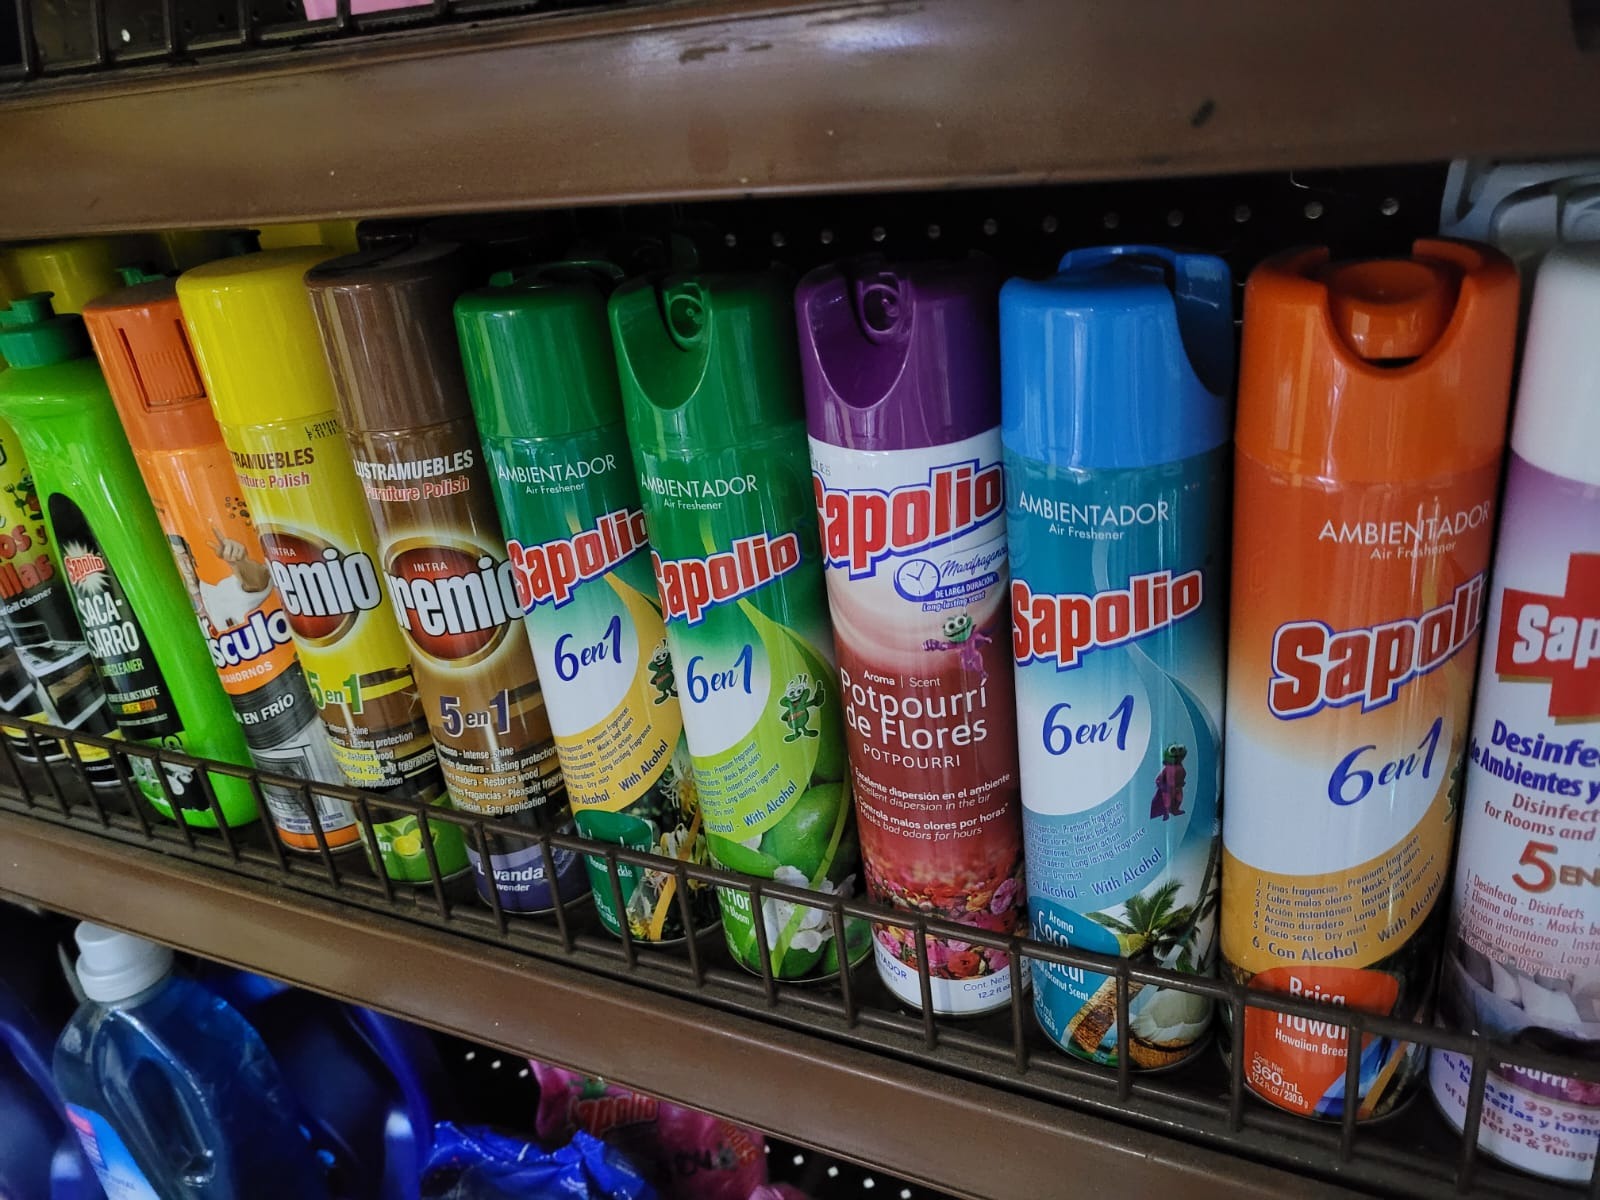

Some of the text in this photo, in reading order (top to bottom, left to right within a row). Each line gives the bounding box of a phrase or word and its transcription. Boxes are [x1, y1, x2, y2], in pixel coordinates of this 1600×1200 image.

[269, 472, 310, 488] Polish
[354, 450, 474, 481] LUSTRAMUEBLES
[498, 454, 616, 483] AMBIENTADOR
[423, 475, 470, 499] Polish
[541, 482, 584, 494] Freshener
[642, 472, 758, 498] AMBIENTADOR
[664, 499, 722, 510] Air Freshener
[1019, 491, 1169, 526] AMBIENTADOR
[1049, 524, 1124, 540] Air Freshener
[1319, 501, 1490, 544] AMBIENTADOR
[507, 508, 649, 613] Sapolio
[1370, 541, 1456, 560] Air Freshener
[64, 554, 105, 584] Sapolio
[413, 562, 448, 572] INTRA
[271, 547, 382, 617] emio
[384, 556, 523, 636] remio
[935, 589, 944, 599] DE
[944, 584, 966, 597] LARGA
[78, 592, 123, 627] SACA-
[1011, 569, 1202, 668] Sapolio
[87, 621, 139, 658] SARRO
[206, 608, 293, 669] sculo
[1269, 572, 1487, 719] Sapoli
[307, 671, 362, 714] 5 en 1
[863, 670, 940, 688] Aroma Scent
[840, 667, 988, 721] Potpourrí
[244, 711, 259, 725] EN
[261, 693, 295, 721] FRÍO
[439, 689, 510, 738] 5 en 1
[376, 732, 413, 748] protection
[846, 702, 988, 749] de Flores
[463, 748, 489, 760] Intense
[640, 739, 669, 776] Alcohol
[863, 743, 961, 769] POTPOURRI
[1491, 719, 1600, 768] Desinfe
[491, 759, 520, 773] Lasting
[521, 745, 557, 768] protection
[1480, 749, 1581, 796] Ambientes
[484, 768, 539, 787] Restores wood
[508, 780, 541, 798] Pleasant
[582, 772, 641, 804] Alcohol With
[889, 773, 1010, 802] dispersión en el ambiente
[487, 804, 504, 814] Easy
[504, 796, 547, 815] application
[743, 779, 797, 826] With Alcohol
[890, 796, 975, 812] dispersion in the
[882, 822, 983, 841] bad odors for hours
[890, 816, 921, 829] malos
[923, 822, 957, 831] olores
[959, 817, 977, 830] por
[1063, 818, 1090, 834] Premium
[1484, 800, 1596, 841] for Rooms and
[1071, 855, 1089, 868] Long
[1089, 849, 1114, 865] lasting
[1114, 827, 1146, 854] fragrance
[1099, 832, 1121, 846] action
[477, 863, 544, 880] Lvanda
[1042, 847, 1163, 899] Alcohol With Alcohol
[1266, 848, 1421, 908] Cubre malos olores Masks bad odors
[1267, 881, 1290, 895] Finas
[1292, 884, 1338, 897] fragancias
[1347, 865, 1384, 889] Premium
[1512, 839, 1558, 894] 5
[1264, 902, 1294, 917] Acción
[1361, 888, 1391, 908] Instant
[1471, 889, 1585, 935] Elimina olores Masks
[1474, 875, 1585, 920] Desinfecta Disinfects
[1049, 910, 1074, 933] Aroma
[1264, 915, 1295, 929] Aroma
[1298, 920, 1344, 930] duradero
[1353, 906, 1378, 923] Long
[1267, 871, 1441, 961] Con Alcohol With Alcohol
[1470, 904, 1493, 926] Acción
[1264, 924, 1367, 944] Rocío seco Dry mist
[1495, 935, 1544, 959] duradero
[1560, 951, 1590, 966] Long
[1068, 982, 1089, 1001] Scent
[1275, 1028, 1318, 1053] Hawaiian
